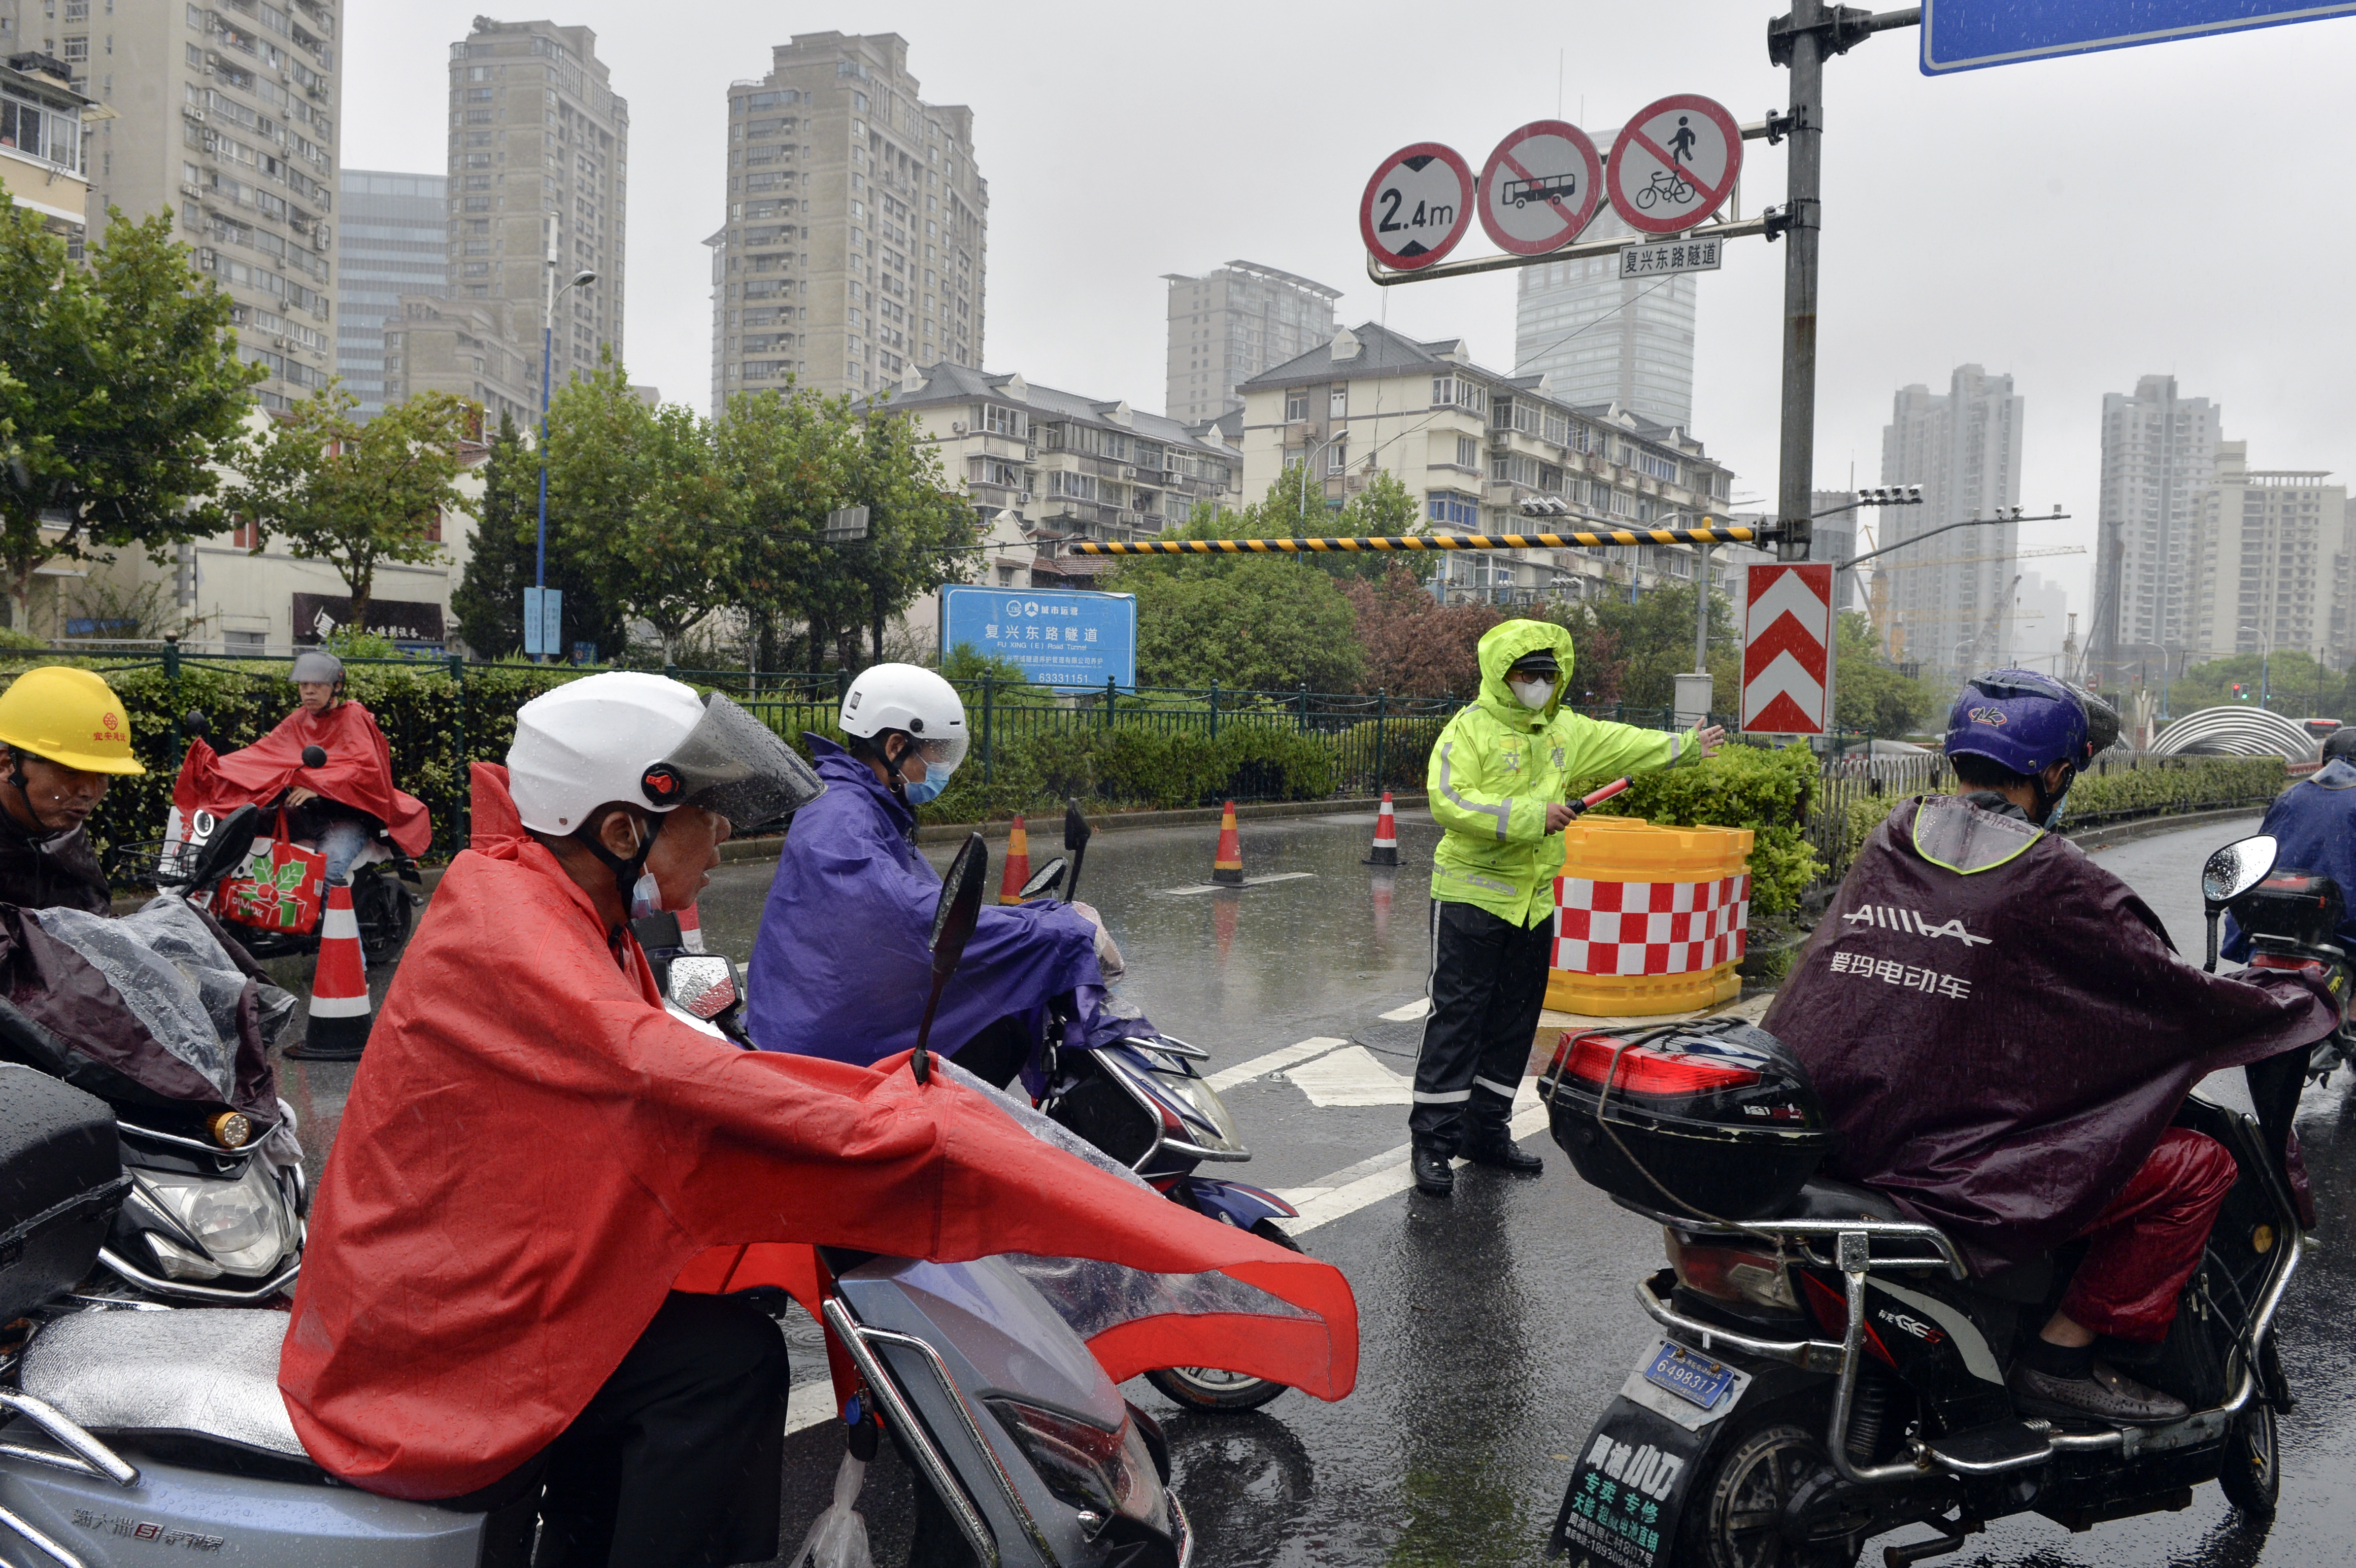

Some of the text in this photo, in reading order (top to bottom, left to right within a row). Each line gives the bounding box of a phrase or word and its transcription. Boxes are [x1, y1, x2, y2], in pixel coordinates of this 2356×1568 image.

[1379, 188, 1453, 232] 2.4m
[1625, 242, 1716, 273] 复兴东路隧道
[1041, 605, 1078, 616] 城市运营
[985, 624, 1097, 642] 复兴东路隧道
[1039, 673, 1088, 683] 63331151
[94, 732, 126, 742] 宜安建设
[1830, 951, 1972, 999] 爱玛电动车
[1657, 1359, 1718, 1394] 6498317
[1586, 1434, 1684, 1502] 周浦小刀
[1572, 1491, 1596, 1518] 天能
[1585, 1472, 1659, 1523] 专卖 专修
